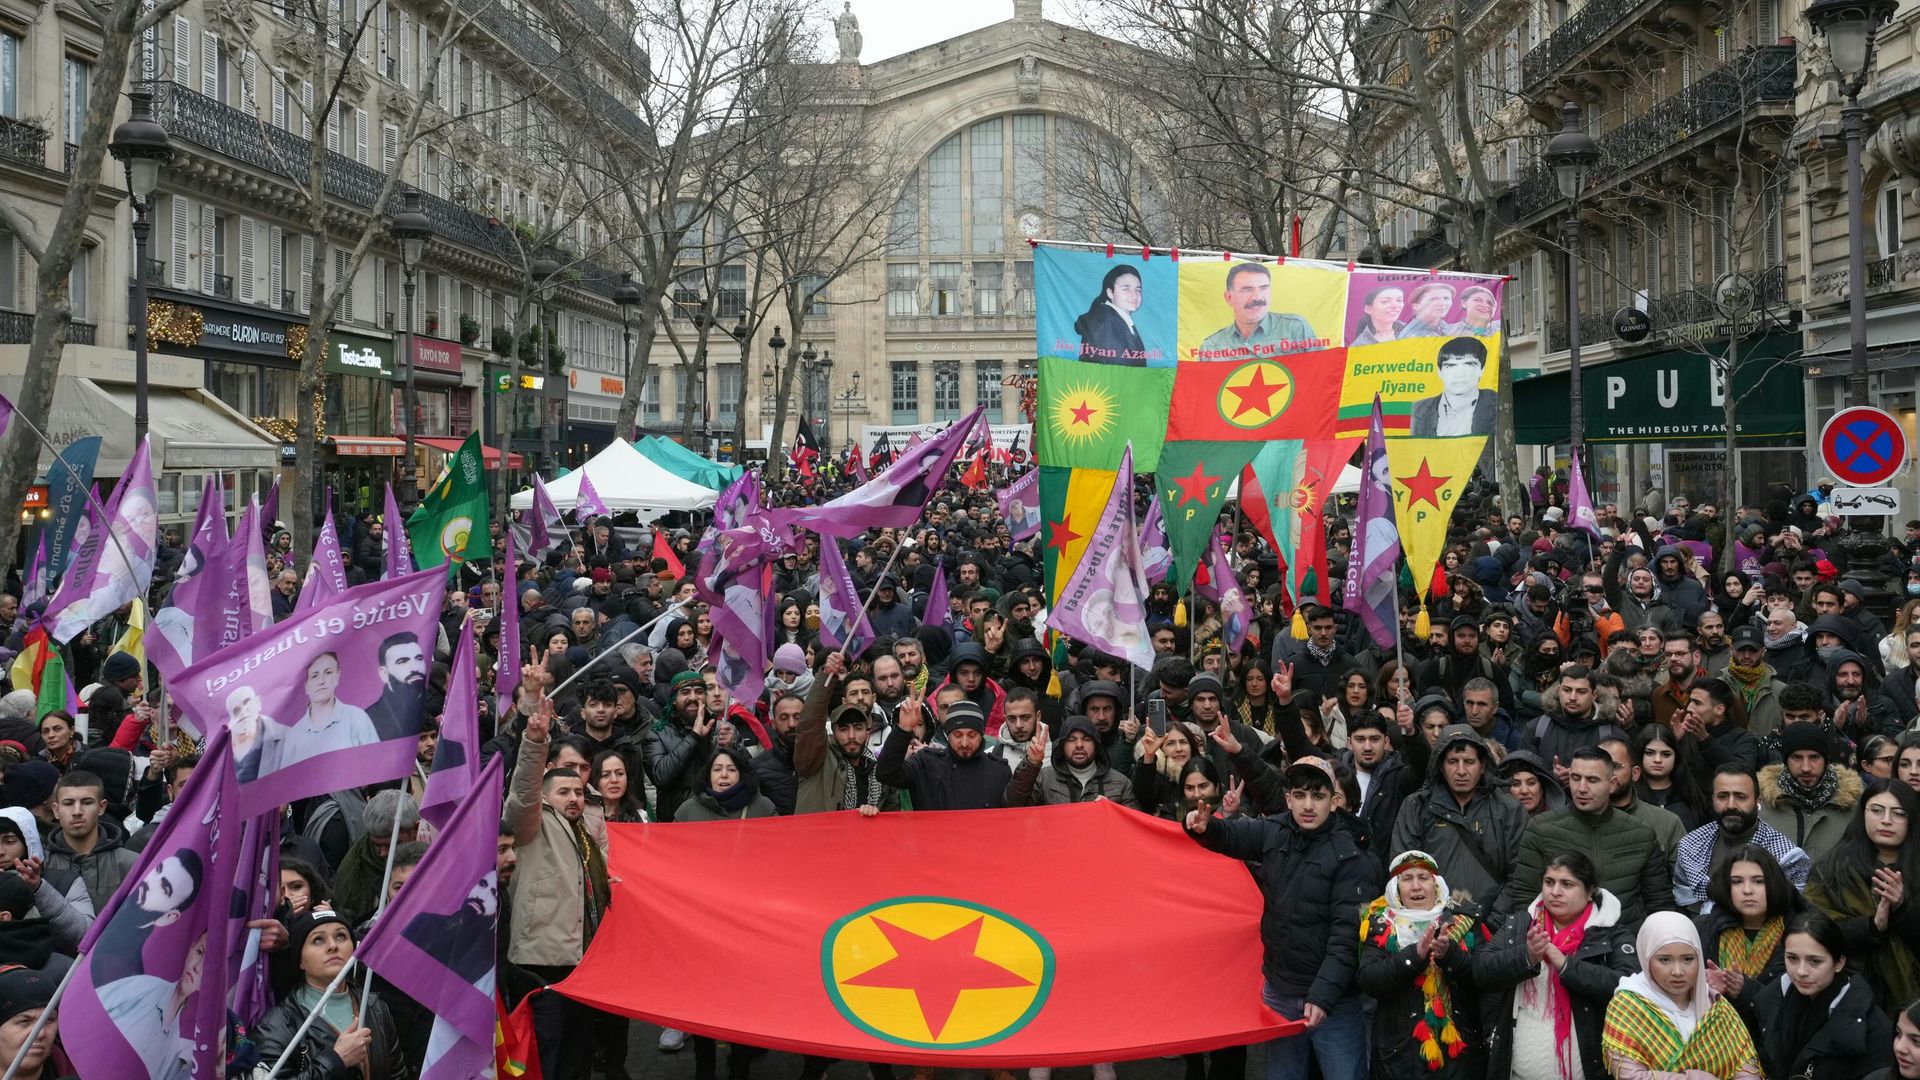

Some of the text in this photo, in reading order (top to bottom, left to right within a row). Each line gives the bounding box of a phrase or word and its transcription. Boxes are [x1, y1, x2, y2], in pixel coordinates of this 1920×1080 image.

[232, 323, 260, 345] BURDIN
[1620, 324, 1647, 333] GUINNESS
[338, 343, 360, 366] Taste
[419, 347, 437, 362] RAYON
[914, 341, 1024, 352] GARE DU
[1079, 342, 1117, 358] Jiyan
[1190, 347, 1250, 359] Freedom
[1253, 343, 1276, 356] For
[1353, 359, 1434, 376] Berxwedan
[1379, 379, 1425, 396] Jîyane
[1606, 357, 1730, 410] PUB
[1608, 423, 1743, 435] THE HIDEOUT PARS
[281, 447, 296, 455] AQUILL
[1167, 487, 1219, 521] Y P J
[1394, 489, 1452, 523] Y P G
[51, 516, 67, 566] marché
[326, 549, 339, 567] et
